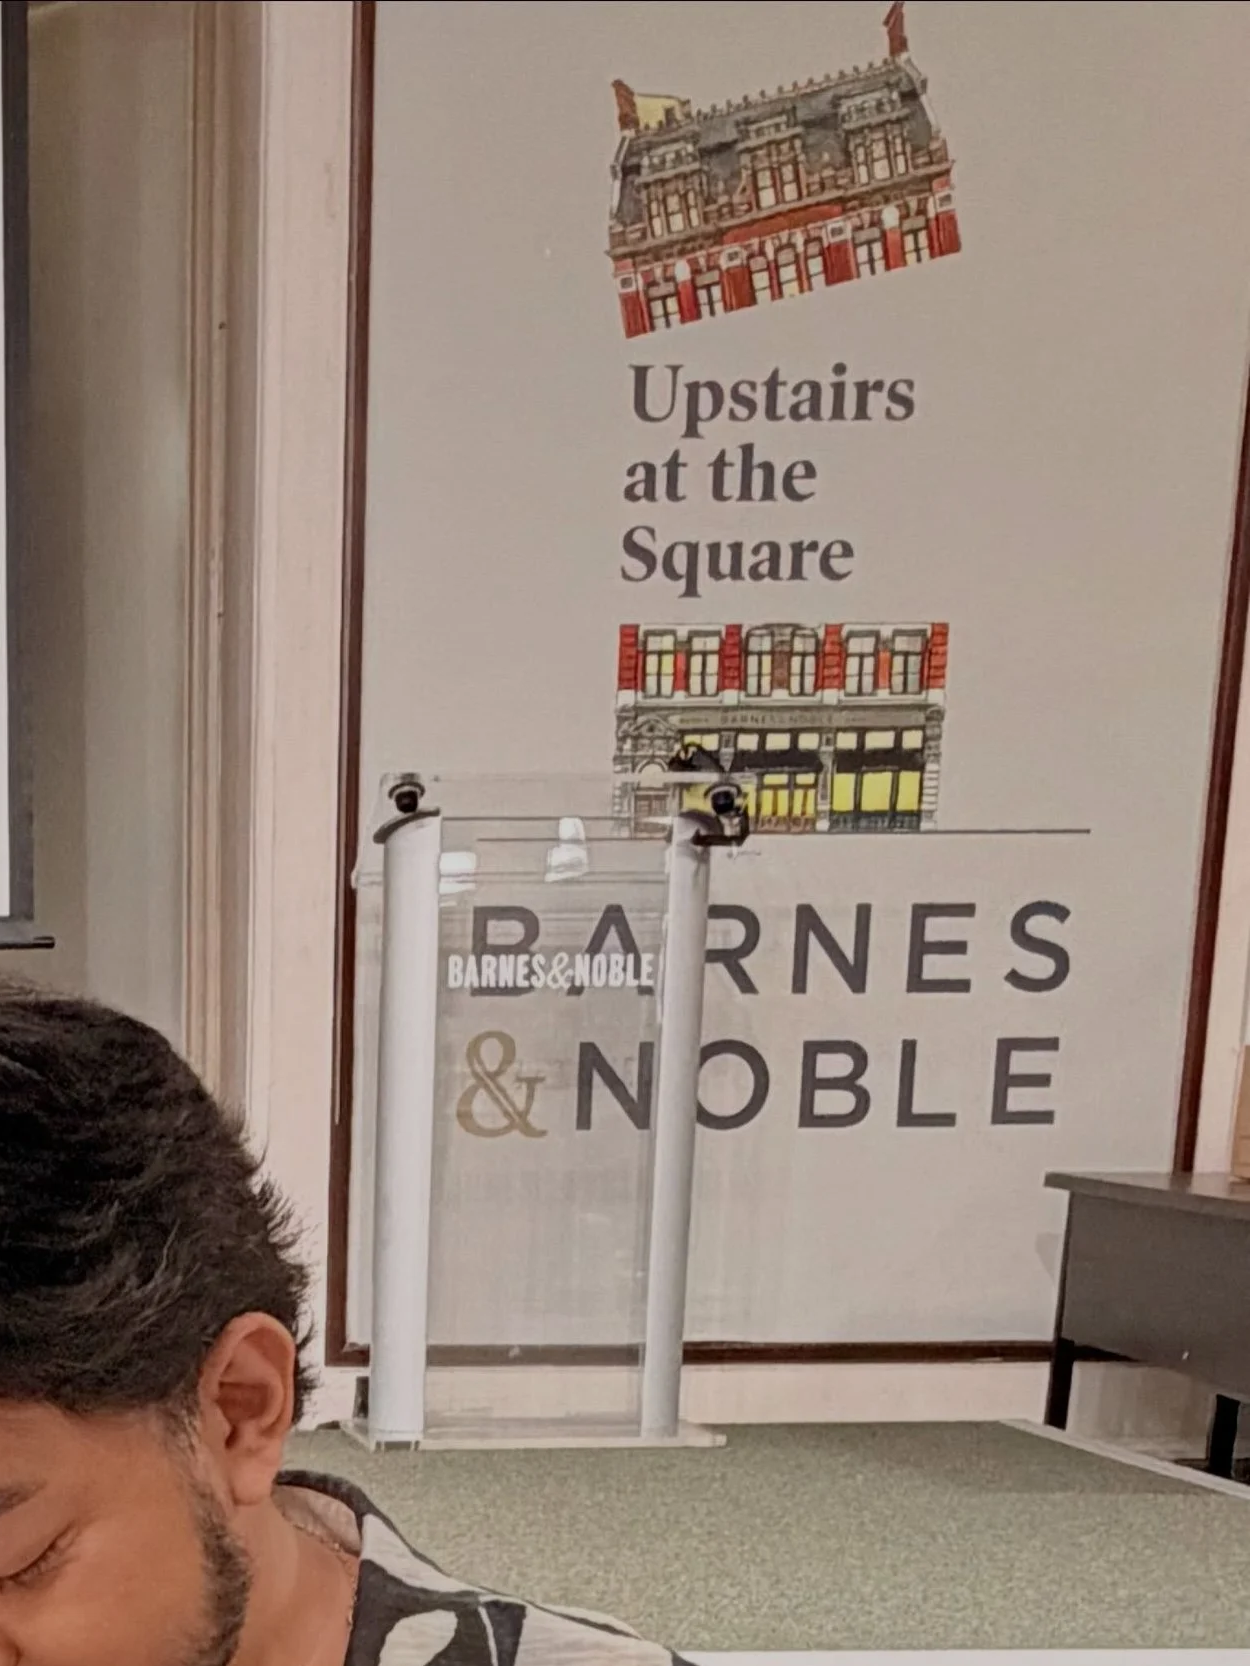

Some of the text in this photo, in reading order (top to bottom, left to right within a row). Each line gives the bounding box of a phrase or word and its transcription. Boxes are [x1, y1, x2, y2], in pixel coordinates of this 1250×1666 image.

[630, 362, 916, 438] Upstairs
[623, 443, 818, 503] at the
[620, 525, 855, 598] Square
[471, 900, 1072, 996] BARNES
[455, 1030, 1061, 1138] & NOBLE
